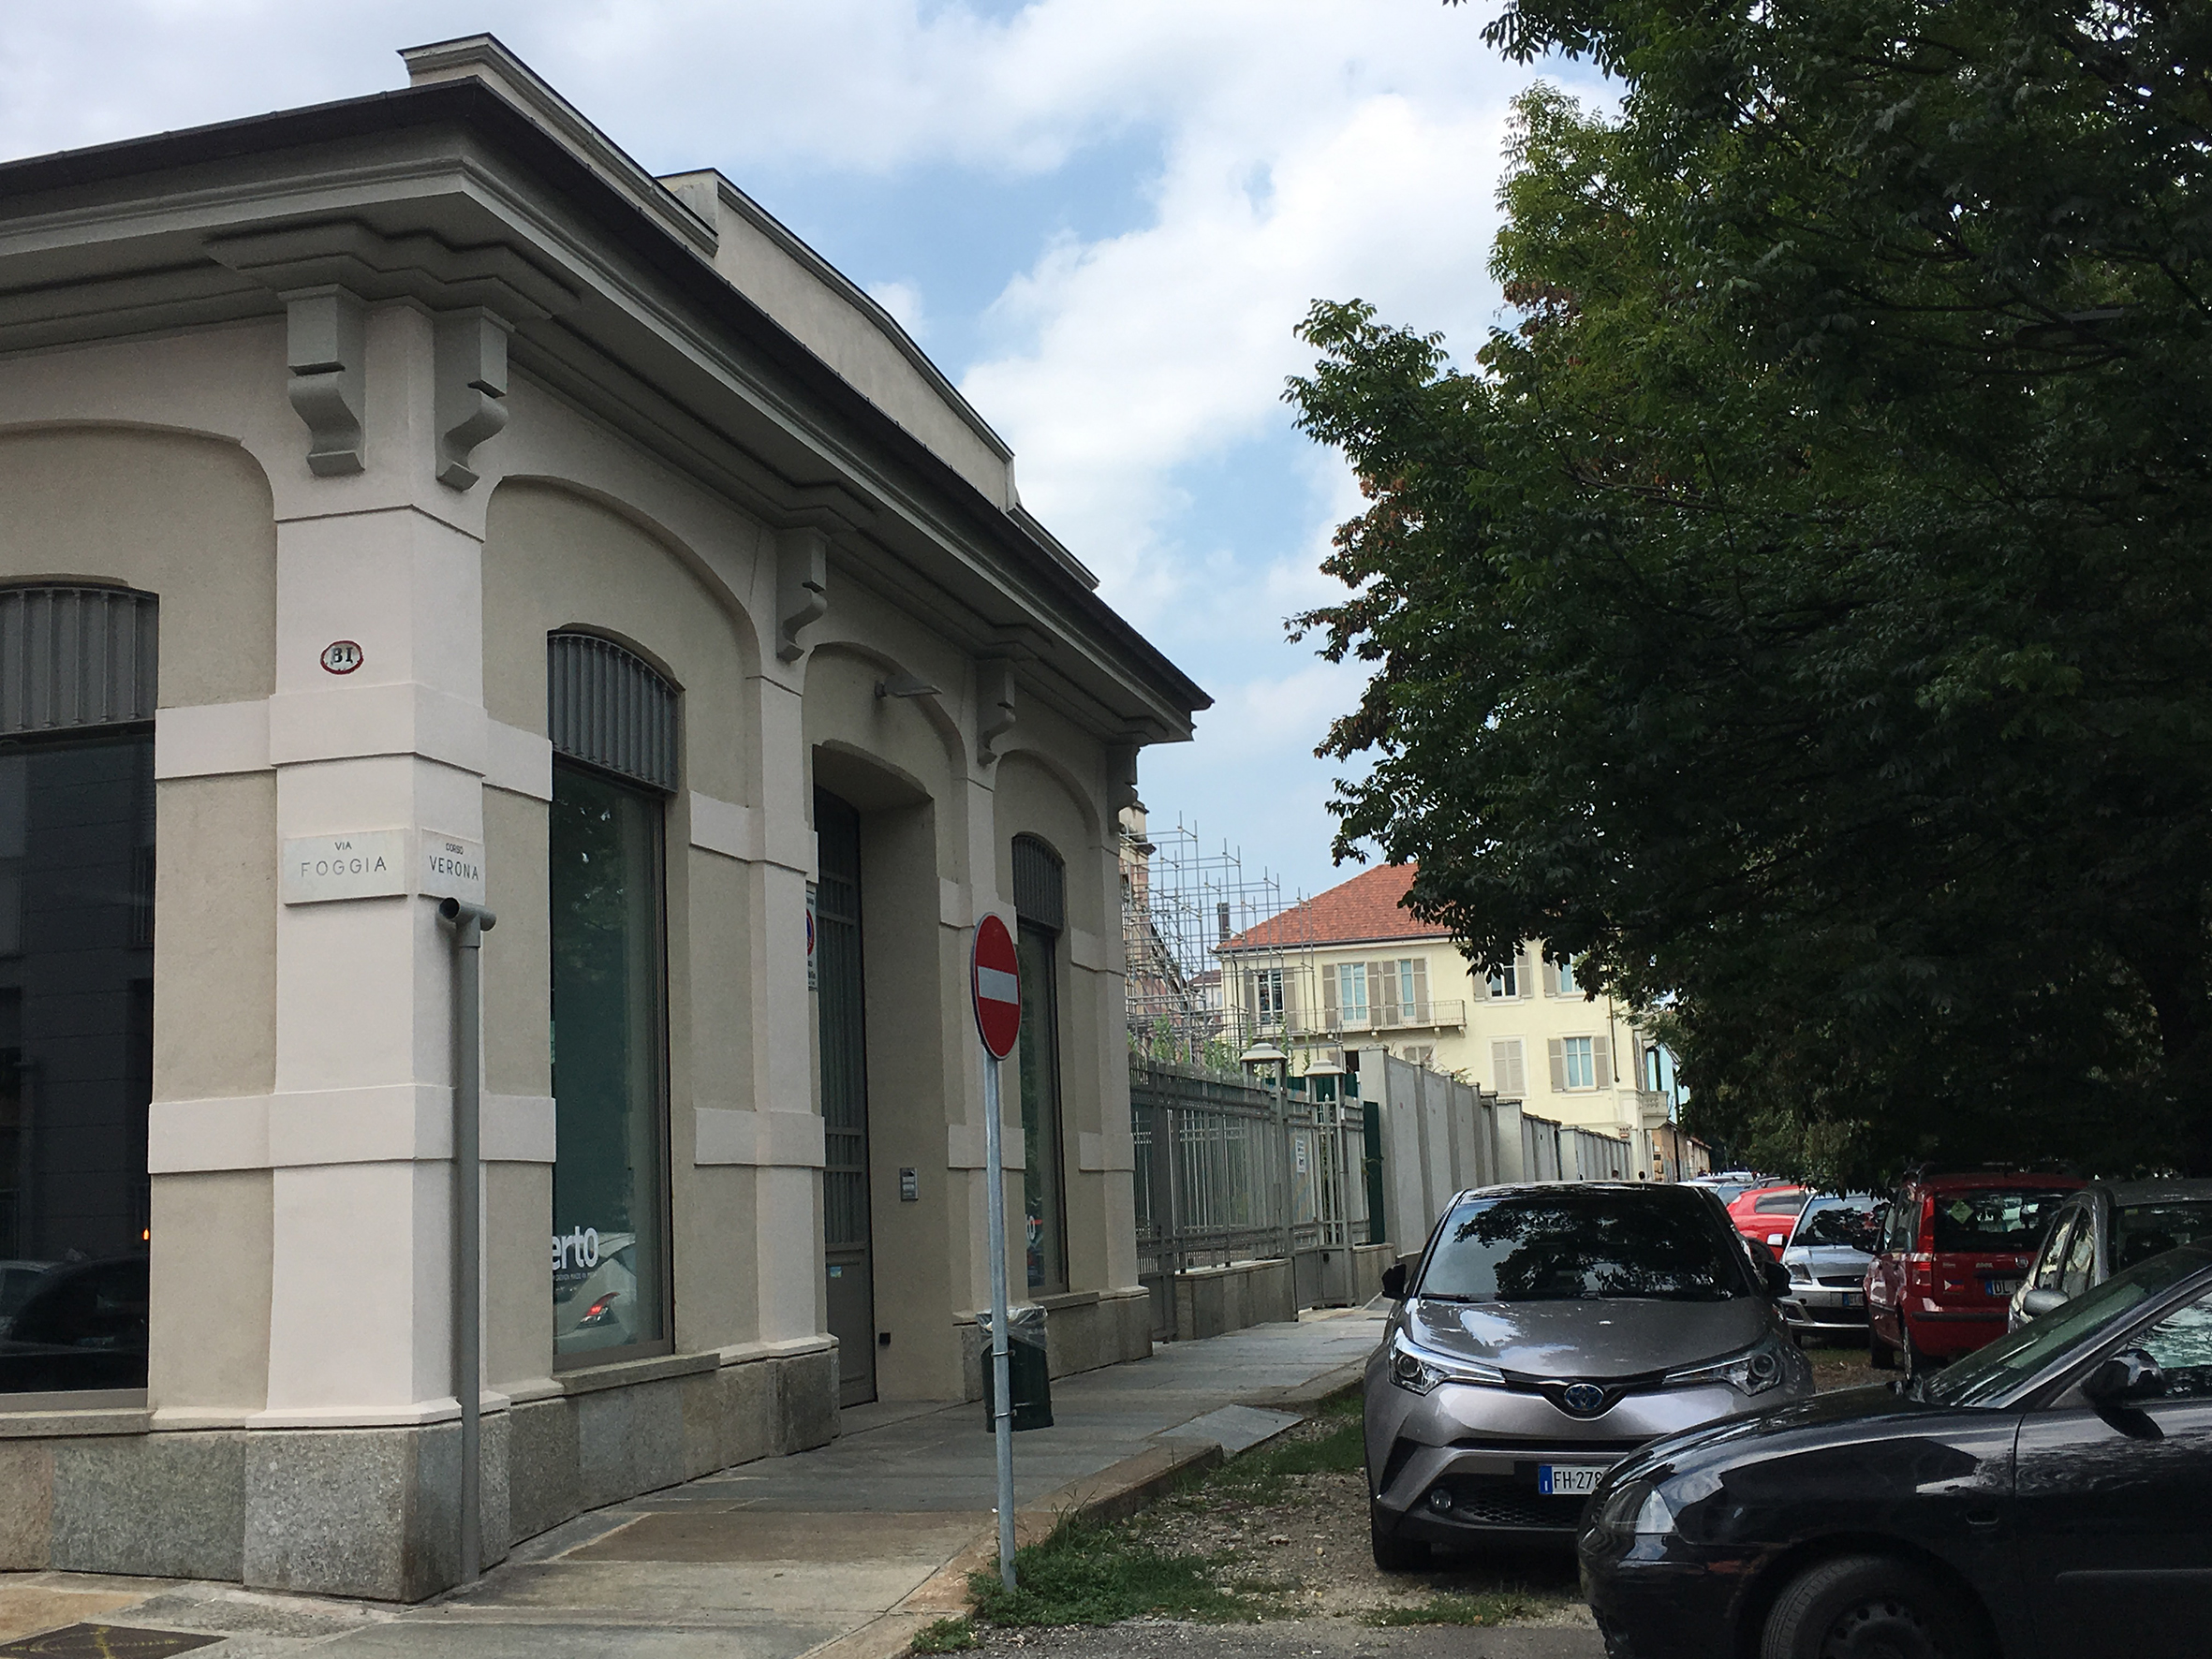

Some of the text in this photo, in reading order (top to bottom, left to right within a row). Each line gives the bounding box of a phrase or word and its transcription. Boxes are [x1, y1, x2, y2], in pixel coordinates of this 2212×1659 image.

[334, 841, 352, 851] VIA
[445, 843, 465, 856] CORSO
[301, 856, 387, 878] FOGGIA
[429, 855, 479, 881] VERONA
